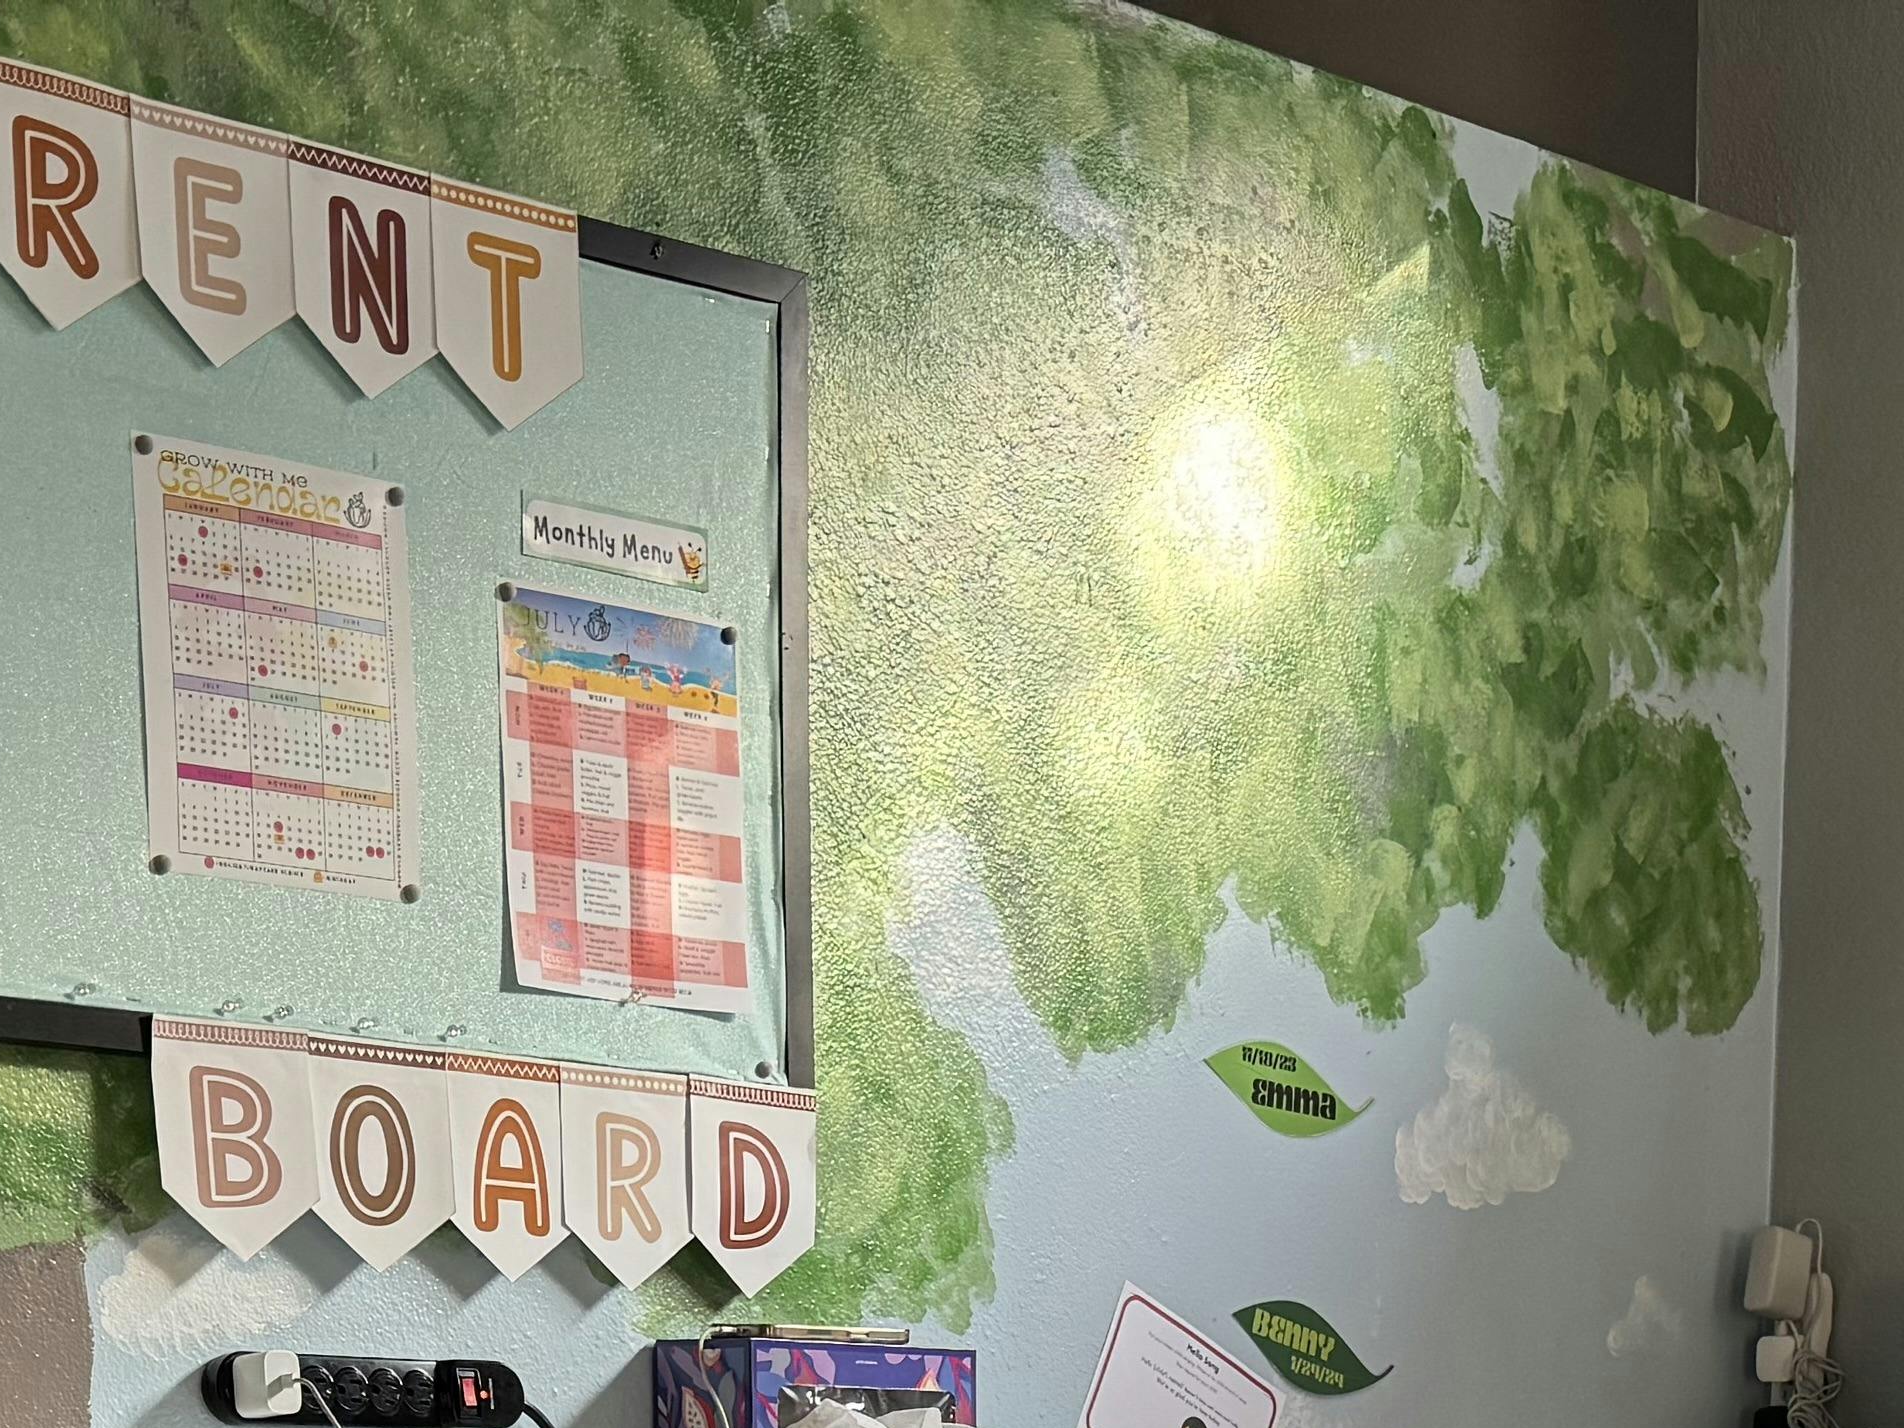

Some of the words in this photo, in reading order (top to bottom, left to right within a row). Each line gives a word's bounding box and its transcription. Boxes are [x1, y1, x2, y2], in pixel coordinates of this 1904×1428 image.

[161, 450, 219, 470] GROW
[226, 461, 273, 481] WITH
[533, 516, 615, 558] Monthly
[623, 534, 672, 564] Menu
[523, 607, 580, 636] JULY
[188, 1065, 791, 1252] BOARD
